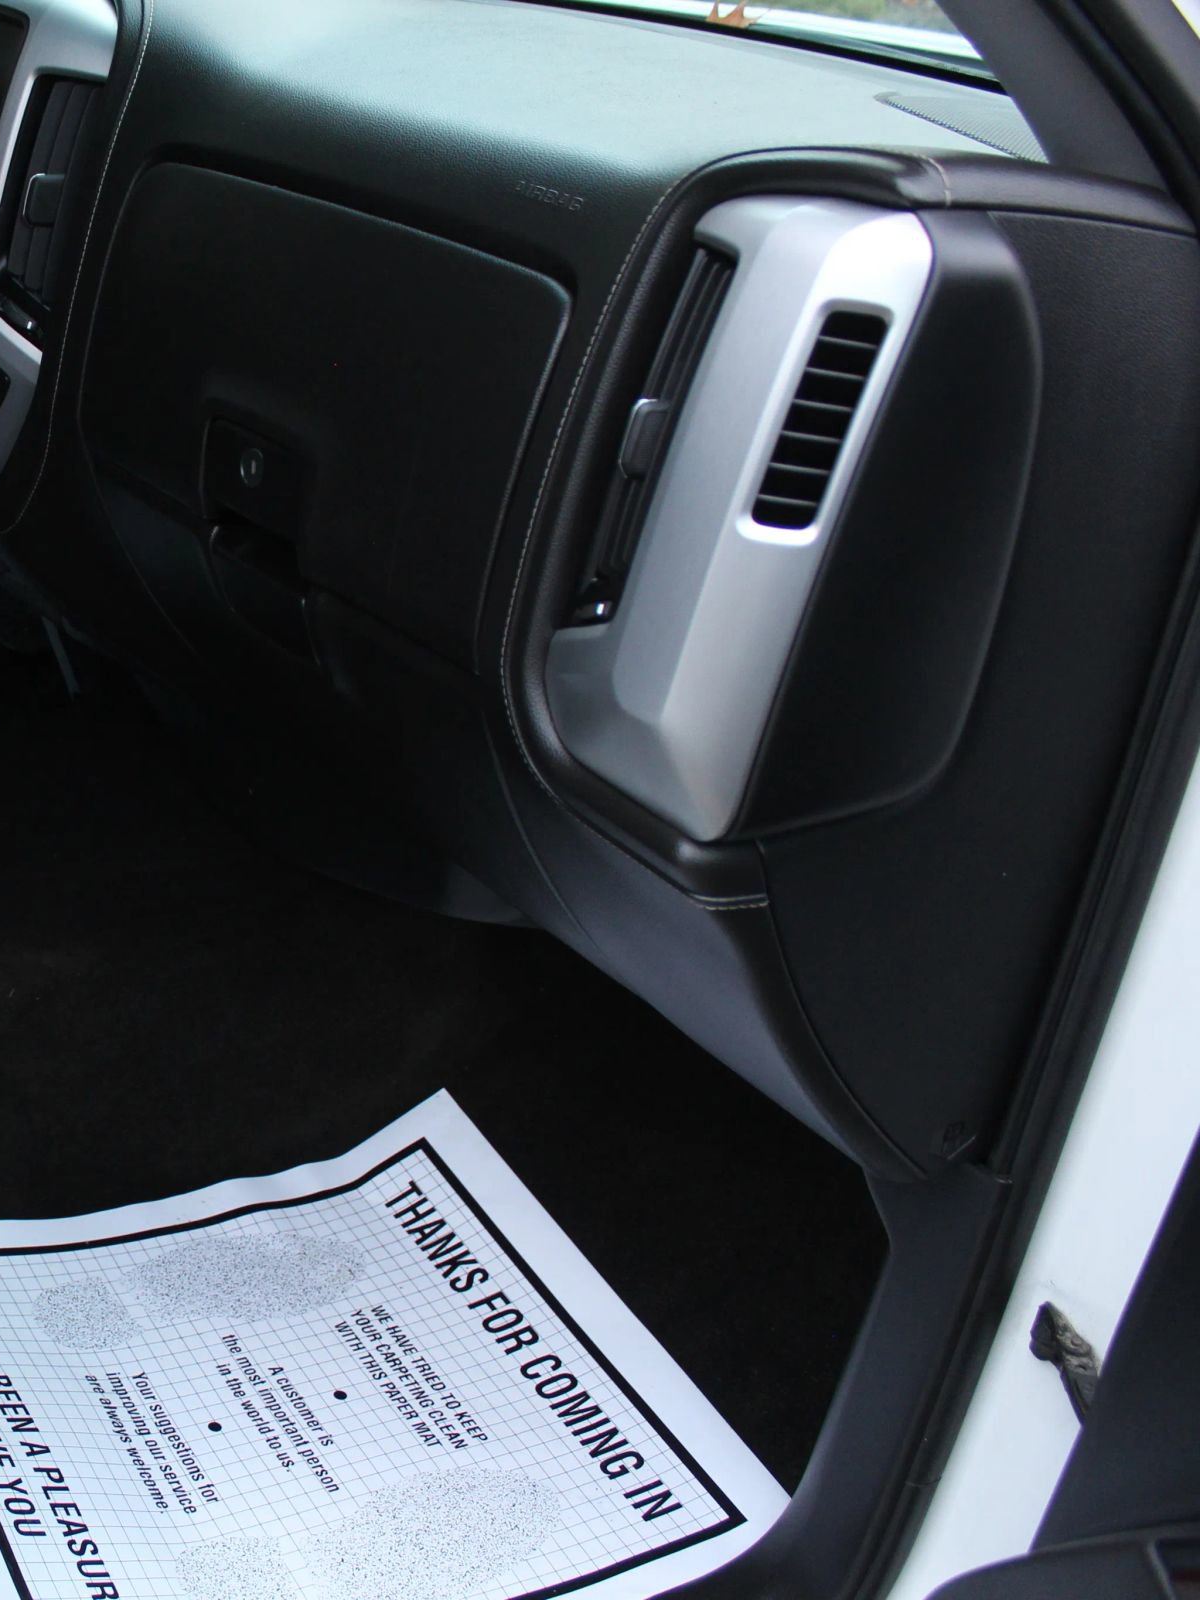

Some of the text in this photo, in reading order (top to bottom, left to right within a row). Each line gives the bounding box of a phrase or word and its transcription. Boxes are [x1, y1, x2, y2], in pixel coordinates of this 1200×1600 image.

[215, 1362, 296, 1473] in the world to us.
[221, 1333, 341, 1493] the most important person
[268, 1365, 334, 1447] A customer is
[334, 1320, 444, 1448] WITH THIS PAPER MAT
[351, 1309, 469, 1450] YOUR CARPETING CLEAN
[371, 1304, 489, 1443] WE HAVE TRIED TO KEEP
[385, 1180, 683, 1522] THANKS FOR COMING IN
[19, 1440, 51, 1458] A
[84, 1373, 169, 1515] are always welcome.
[105, 1371, 198, 1515] improving our service
[131, 1371, 219, 1505] Your suggestions for
